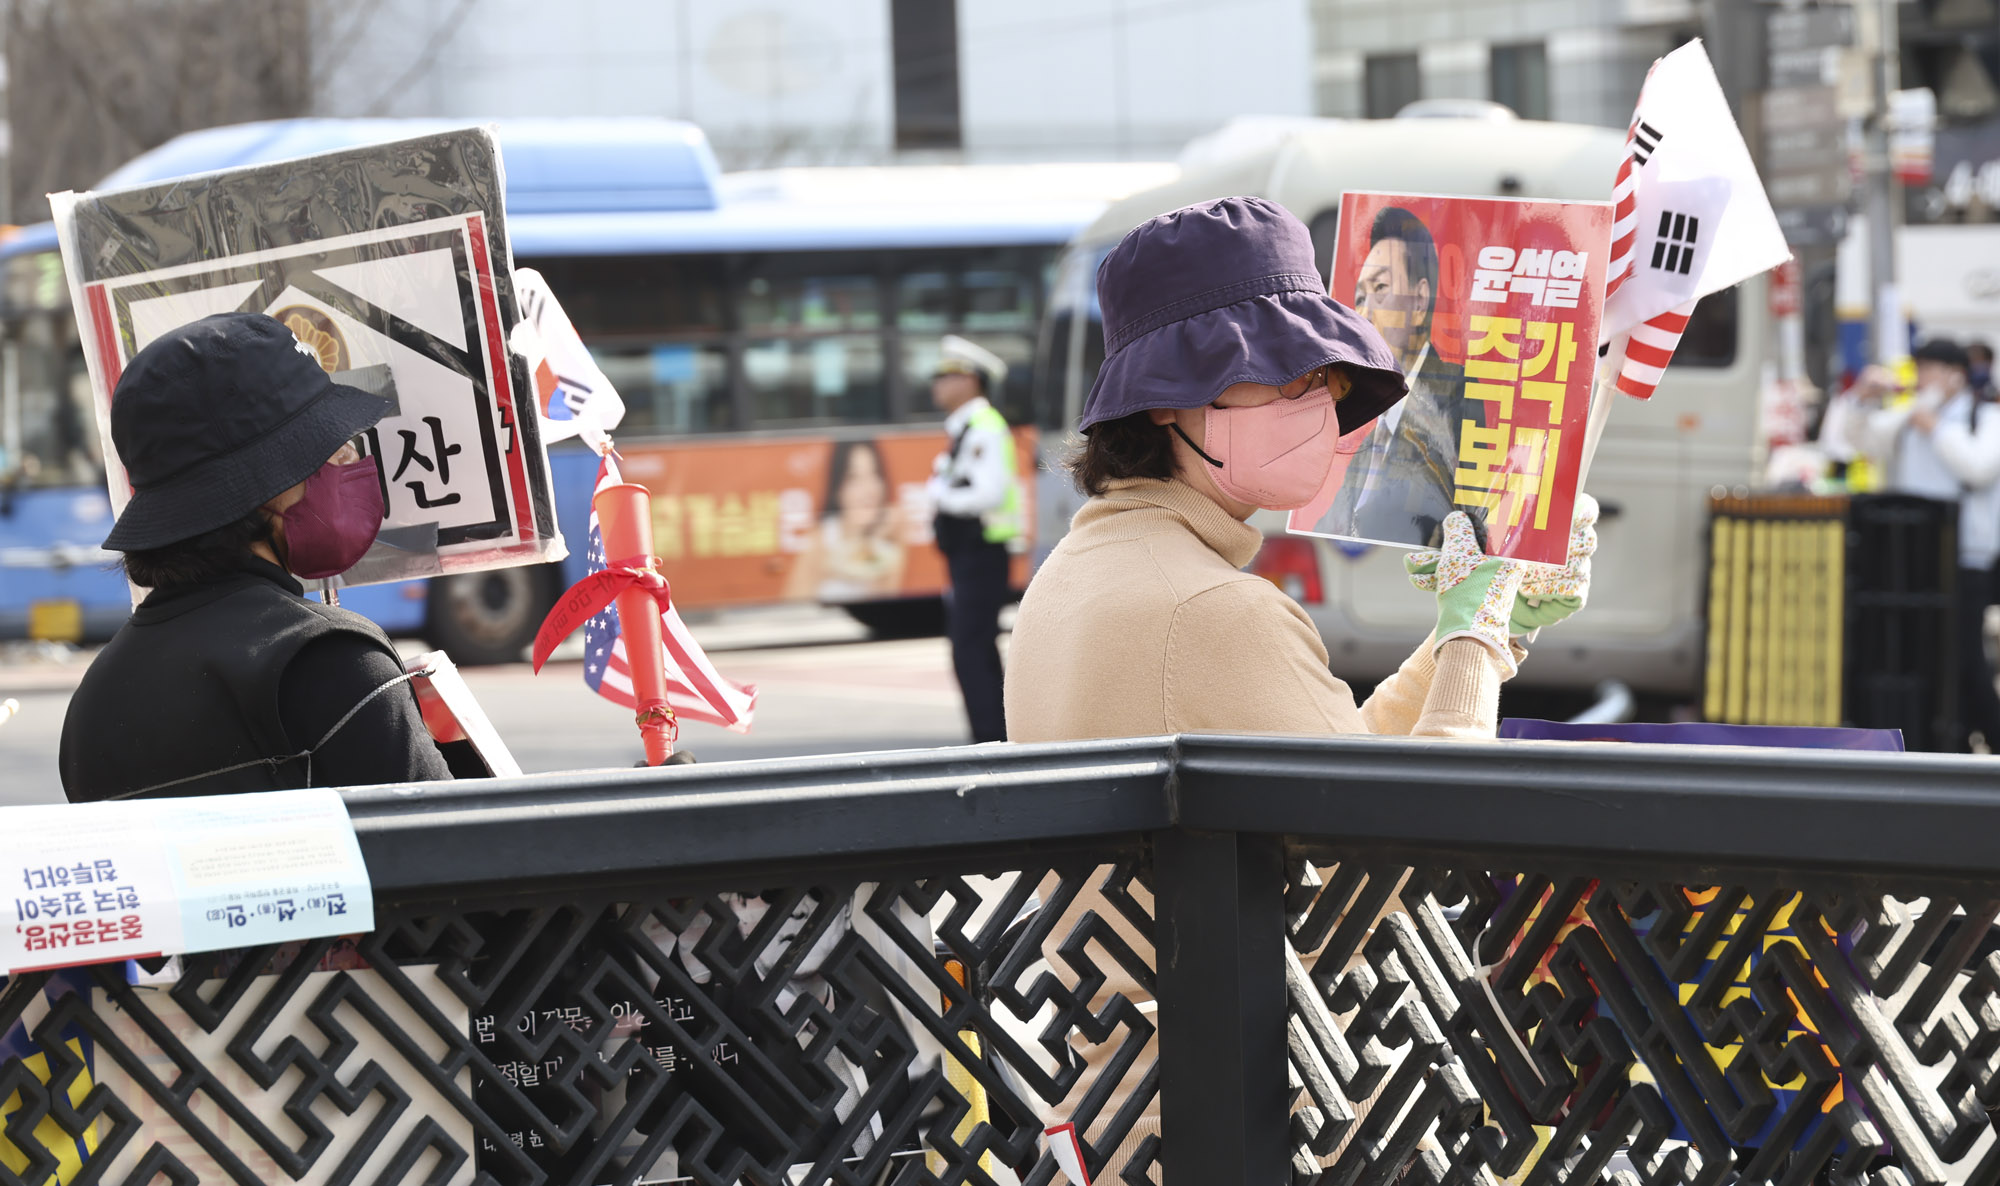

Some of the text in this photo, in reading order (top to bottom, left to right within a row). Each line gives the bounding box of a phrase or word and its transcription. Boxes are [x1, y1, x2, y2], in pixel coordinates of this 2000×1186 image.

[1471, 246, 1589, 308] 윤석열
[1463, 315, 1578, 426] 즉각
[1454, 419, 1562, 531] 복귀
[22, 859, 117, 891] 침투하다
[15, 885, 141, 922] 한국 깊숙이
[15, 914, 144, 953] 중국공산당,
